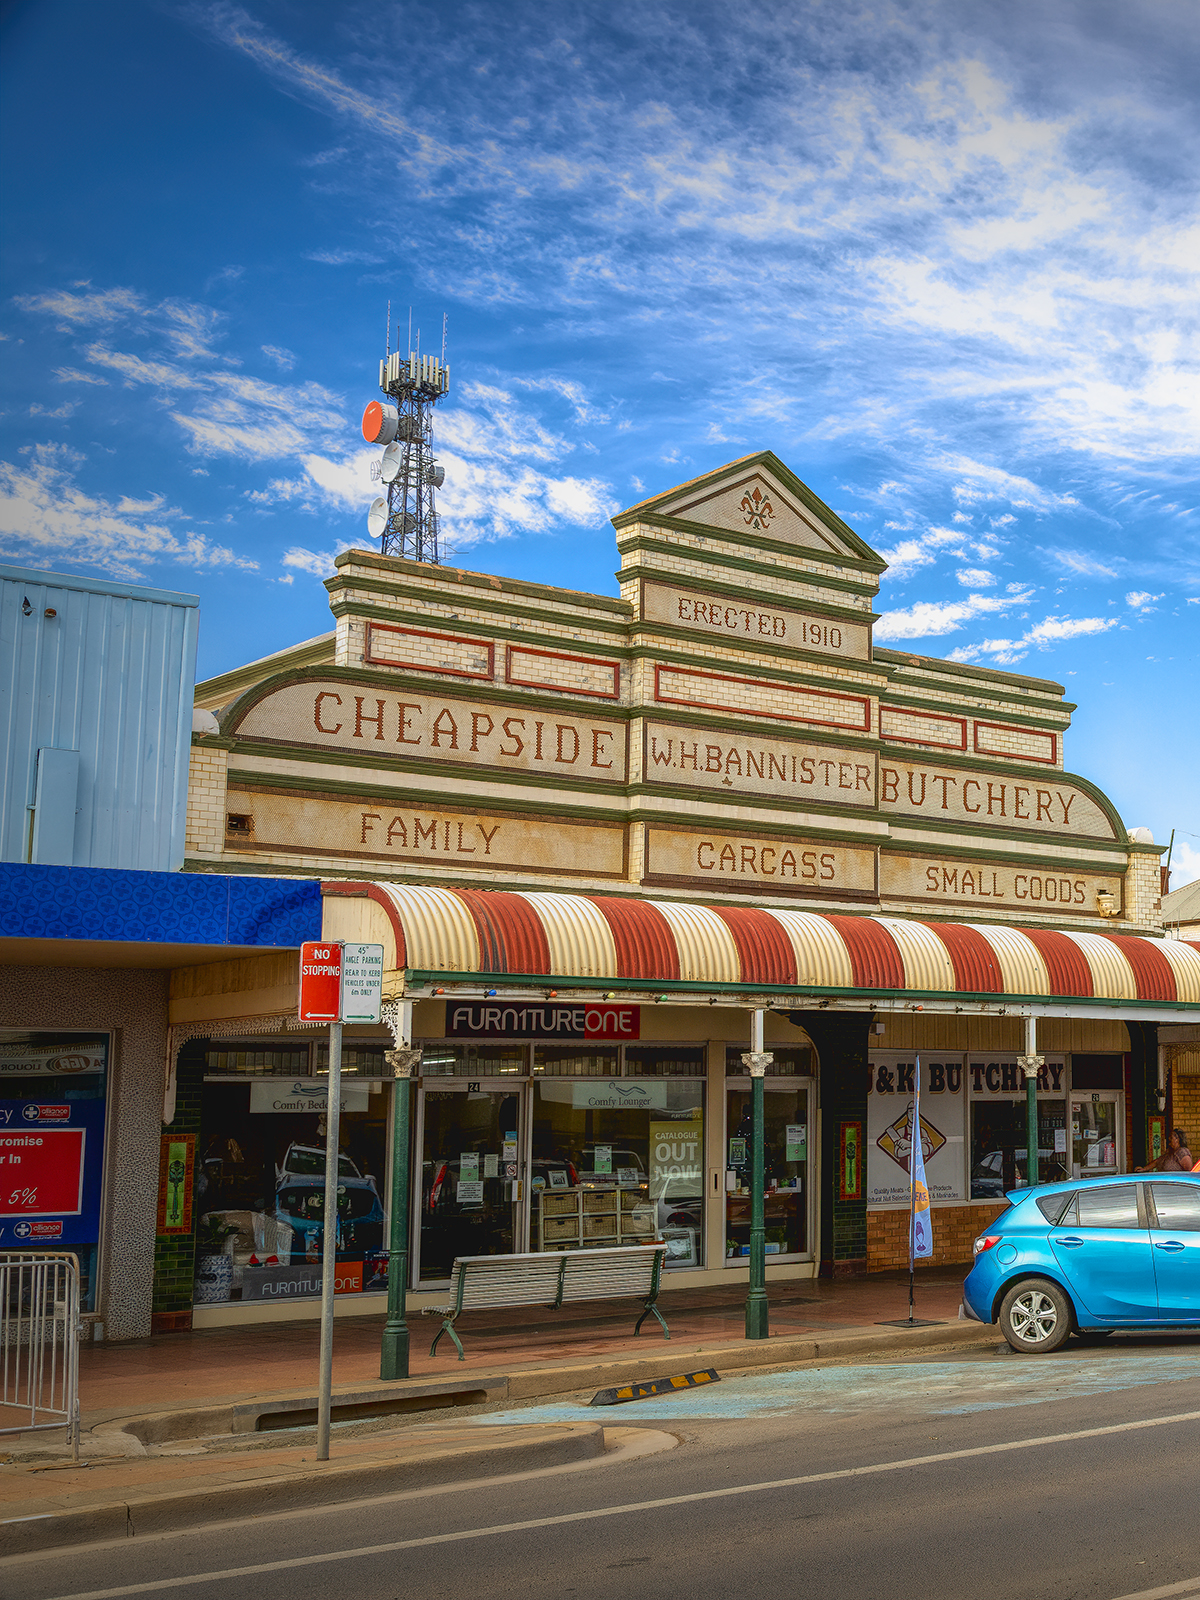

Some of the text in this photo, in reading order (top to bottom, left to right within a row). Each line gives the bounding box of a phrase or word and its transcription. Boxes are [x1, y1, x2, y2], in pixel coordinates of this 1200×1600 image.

[677, 597, 842, 649] ERECTED 1910
[313, 691, 614, 769] CHEAPSIDE
[881, 768, 1076, 826] BUTCHERY
[360, 812, 500, 855] FAMILY
[697, 841, 836, 881] CARCASS
[926, 866, 1087, 905] SMALL GOODS
[314, 949, 331, 960] NO
[346, 955, 381, 965] ANGLE PARKING
[302, 965, 341, 977] STOPPING
[345, 968, 380, 977] REAR TO KERB
[345, 979, 365, 987] VEHICLES
[929, 1063, 1064, 1094] BUTCHRY
[469, 1083, 479, 1092] 24
[272, 1100, 347, 1111] Comfy Bedg
[588, 1097, 651, 1108] Comfy Lounger
[655, 1132, 698, 1140] CATALOGUE
[9, 1154, 21, 1164] In
[655, 1143, 698, 1162] OUT
[655, 1164, 698, 1181] NOW
[8, 1187, 38, 1205] 5%
